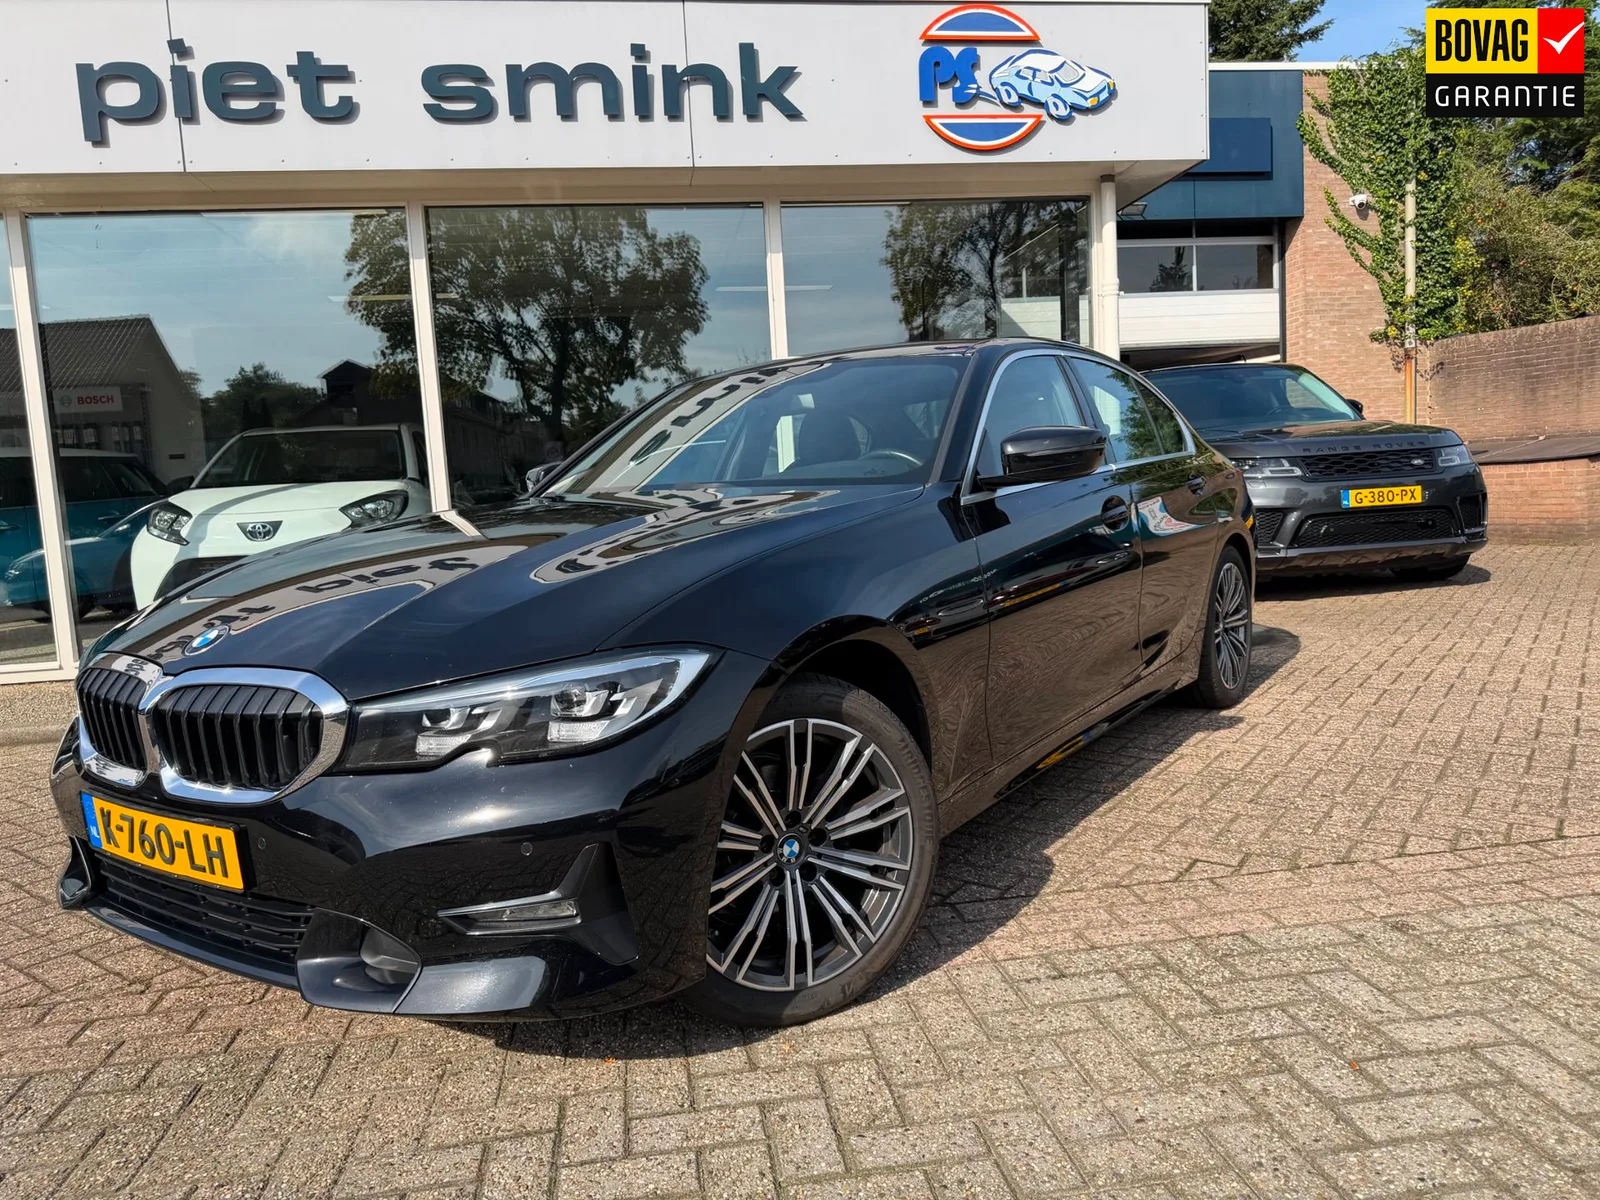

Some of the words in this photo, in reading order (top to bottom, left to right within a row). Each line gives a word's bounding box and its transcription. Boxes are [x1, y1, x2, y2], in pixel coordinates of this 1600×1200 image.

[76, 38, 355, 143] piet
[420, 42, 803, 120] smink
[77, 395, 114, 405] BOSCH
[1302, 445, 1361, 453] RANGE
[1372, 441, 1426, 449] ROVER
[1354, 487, 1417, 504] G-380-PX
[90, 824, 100, 839] NL
[99, 806, 229, 879] K-760-LH
